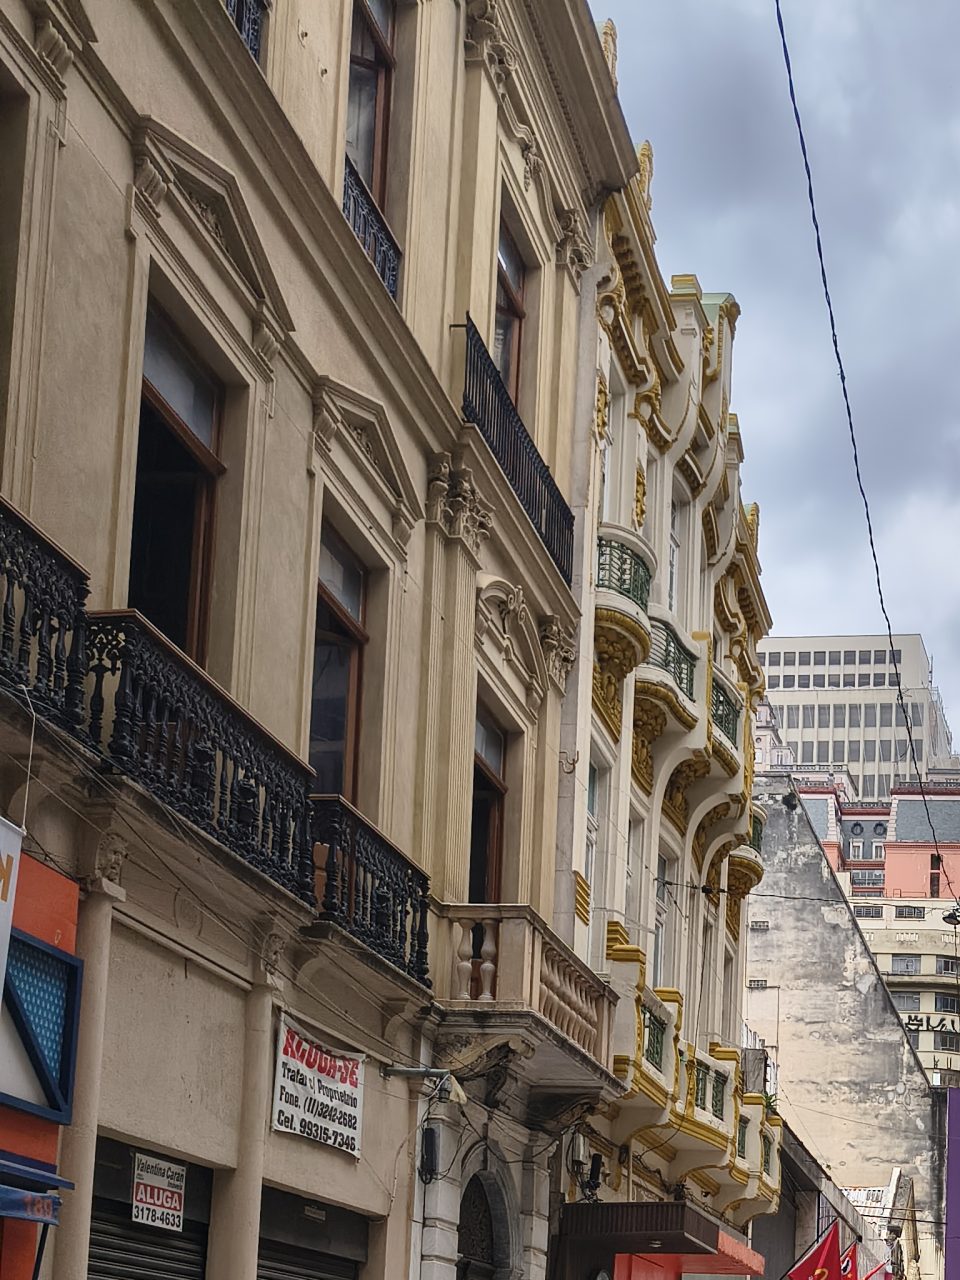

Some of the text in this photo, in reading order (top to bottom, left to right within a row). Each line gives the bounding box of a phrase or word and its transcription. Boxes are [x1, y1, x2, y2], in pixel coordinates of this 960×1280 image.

[283, 1029, 359, 1088] ALUGA-SE
[303, 1096, 357, 1131] (11)3242-2682
[277, 1109, 356, 1152] Cel. 99315-7346
[137, 1158, 166, 1178] Valentina
[166, 1167, 184, 1183] Caran
[137, 1184, 180, 1210] ALUGA
[134, 1205, 181, 1228] 3178-4633
